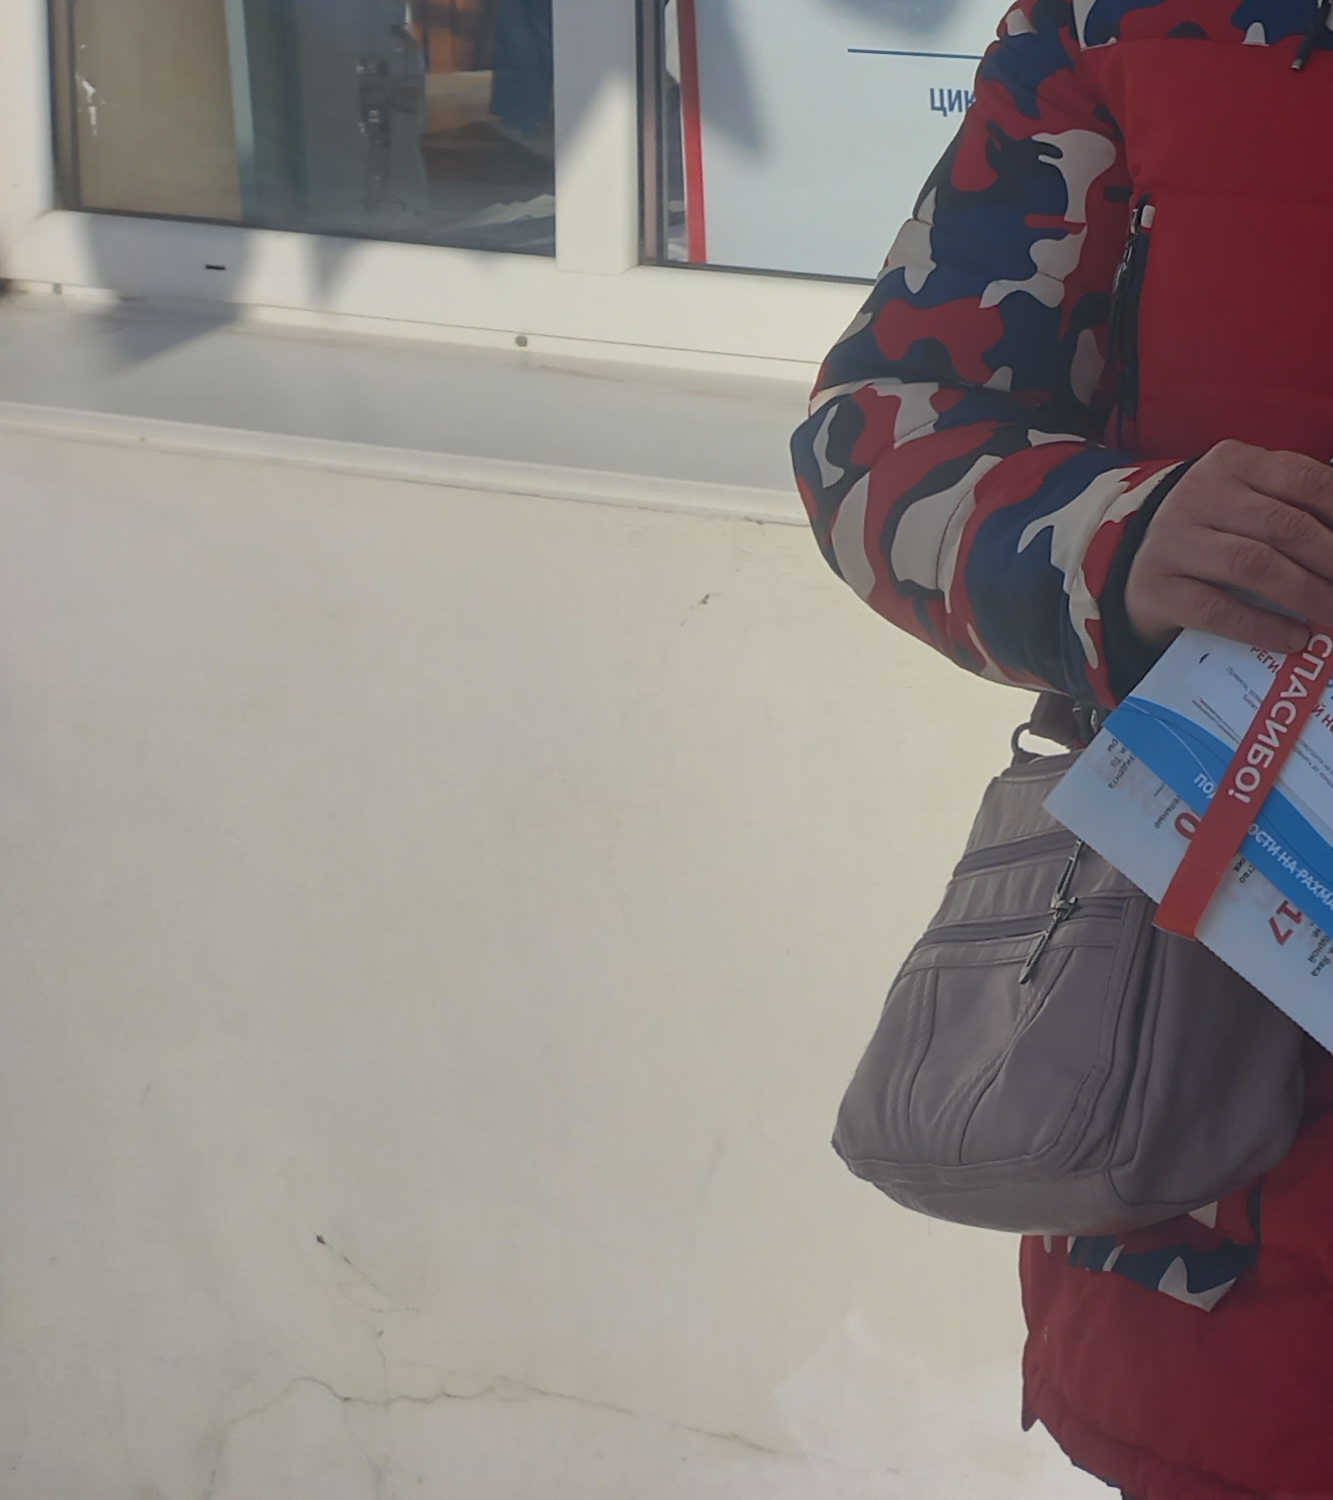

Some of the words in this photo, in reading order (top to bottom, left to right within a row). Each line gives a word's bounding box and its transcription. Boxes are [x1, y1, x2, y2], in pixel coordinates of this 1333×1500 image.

[1275, 850, 1299, 873] НА
[1260, 898, 1306, 946] 17
[1310, 954, 1331, 979] Явка
